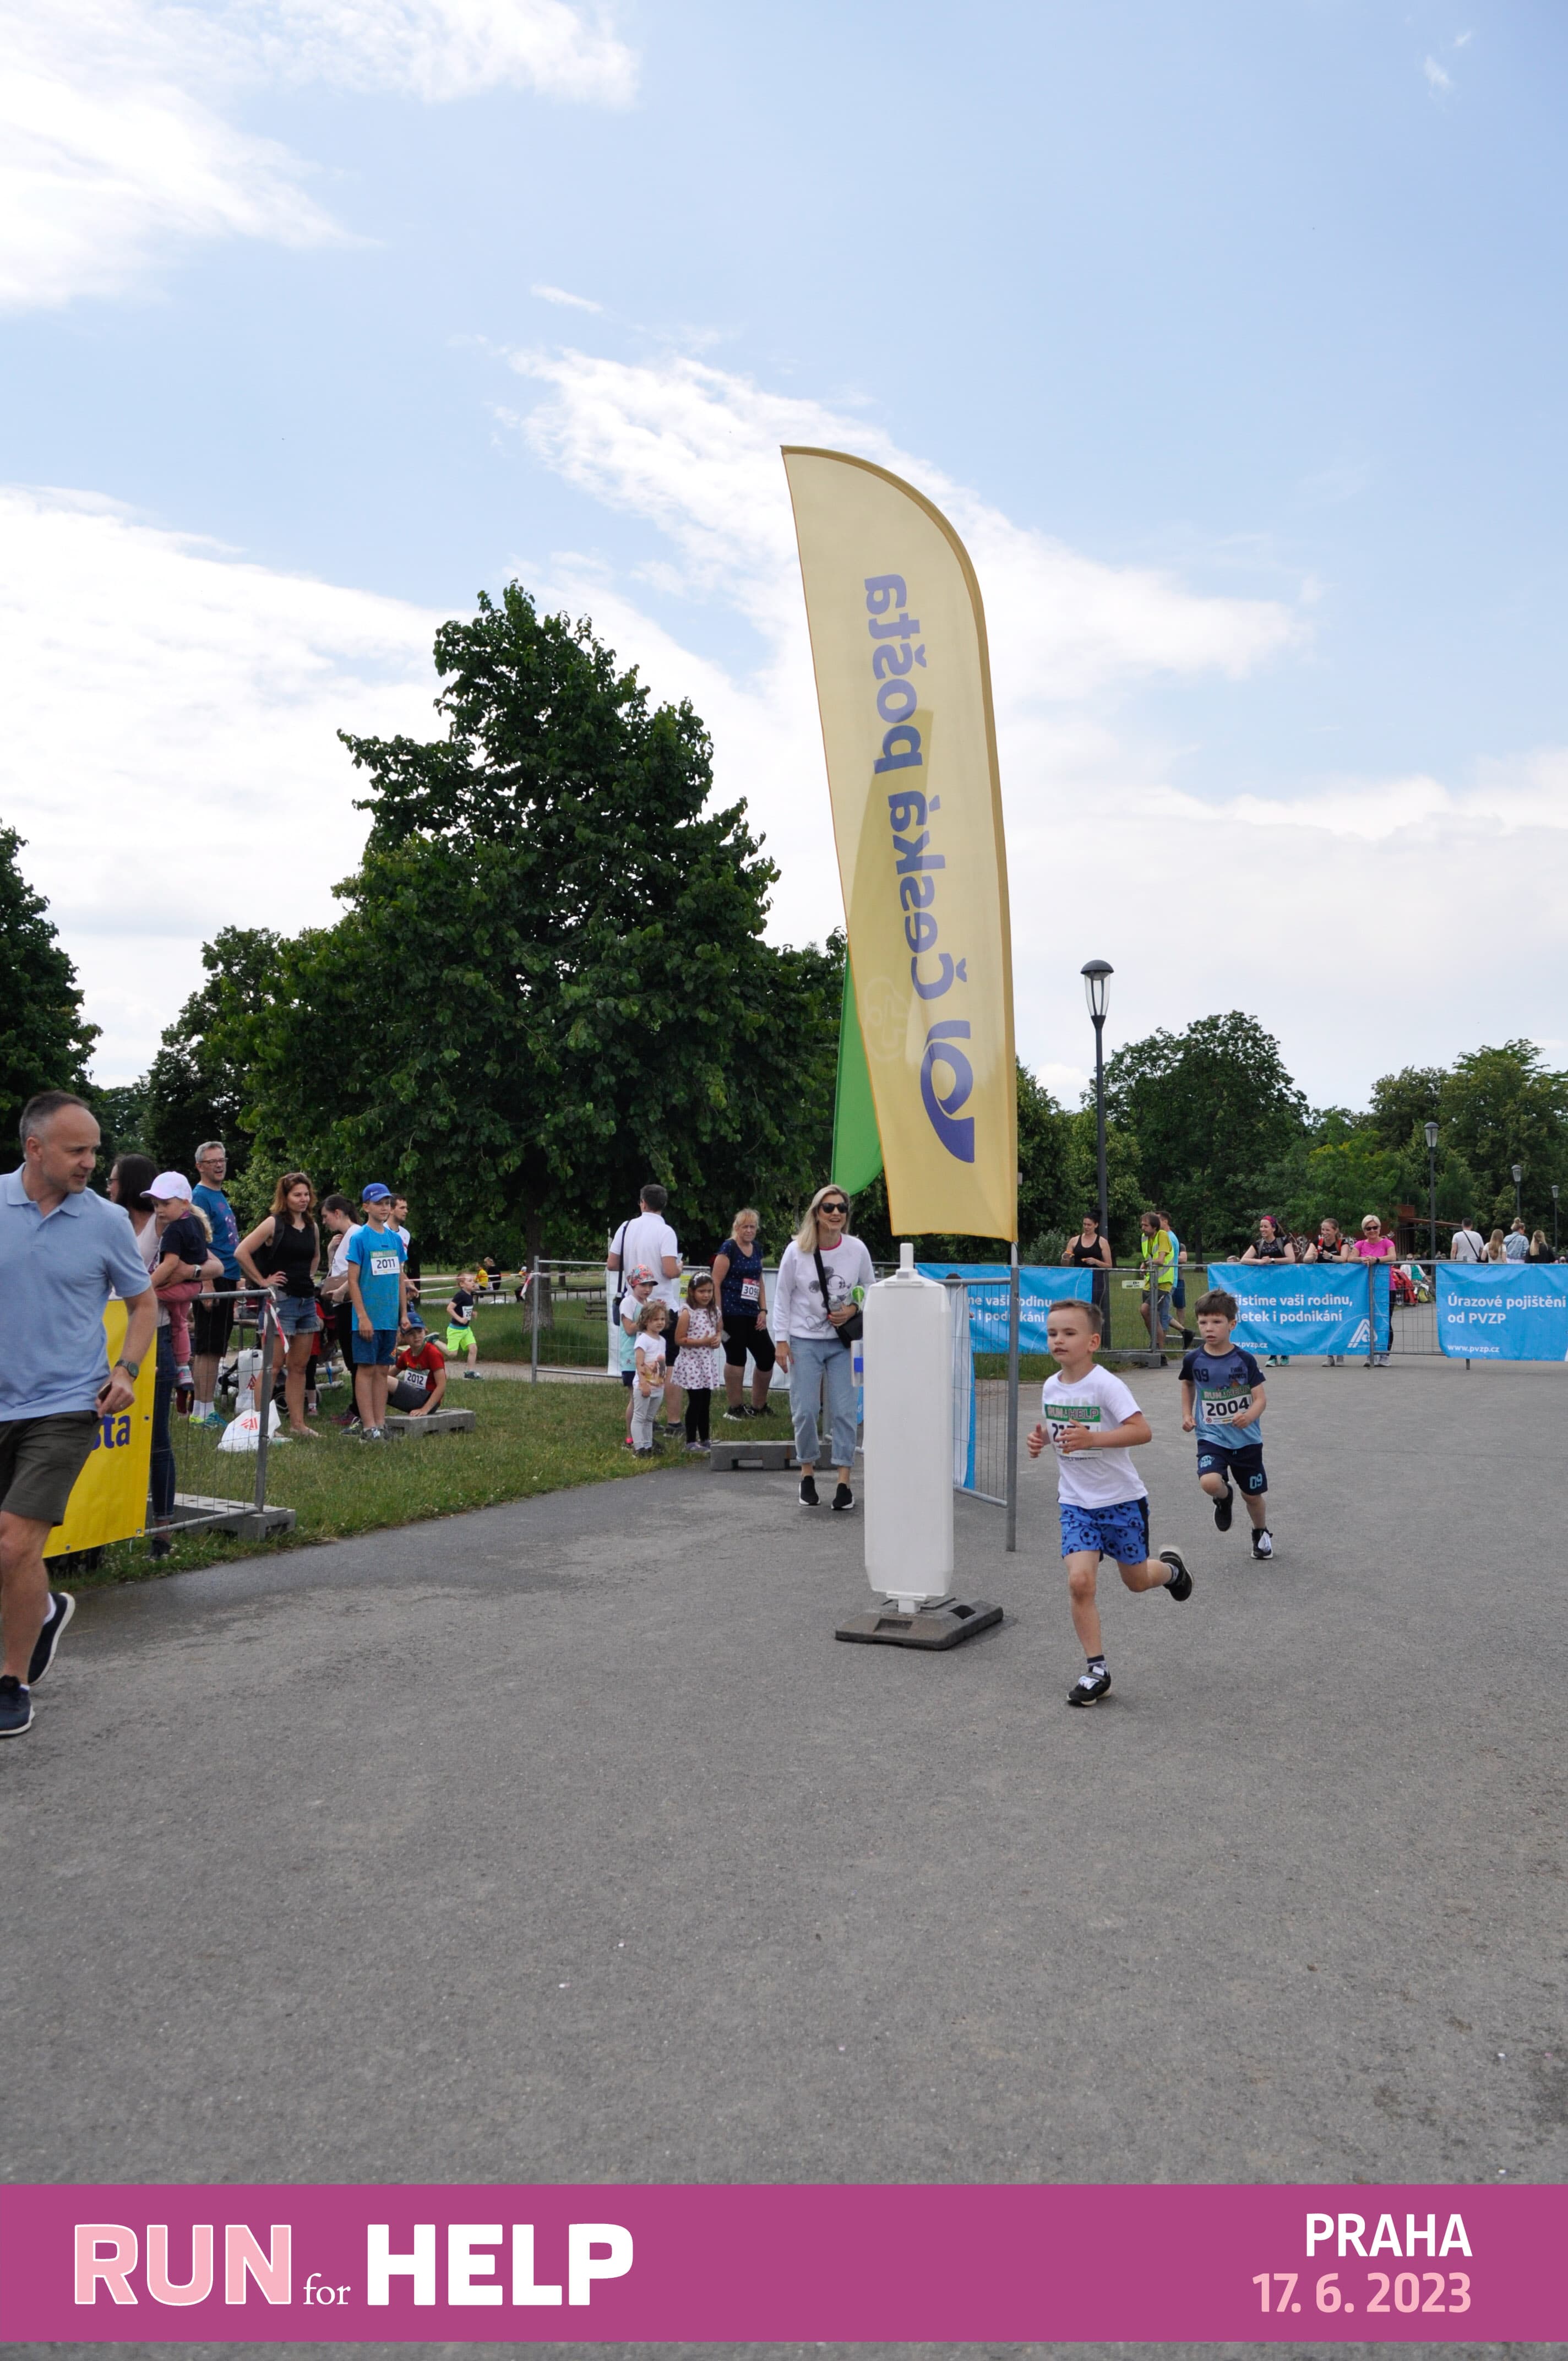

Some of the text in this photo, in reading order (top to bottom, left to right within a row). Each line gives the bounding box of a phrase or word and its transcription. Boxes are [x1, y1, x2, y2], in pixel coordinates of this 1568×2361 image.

[376, 1259, 395, 1269] 2011
[986, 1295, 1010, 1306] vaši
[1017, 1295, 1053, 1307] odinu
[1234, 1294, 1353, 1307] jistíme vaši rodinu,
[1447, 1292, 1566, 1309] Úrazové pojištění
[978, 1310, 982, 1321] i
[985, 1310, 1044, 1323] podkání
[1235, 1310, 1343, 1324] jetek i podnikání
[1447, 1312, 1506, 1324] od PVZP
[1447, 1345, 1500, 1353] www.pvzp.cz
[407, 1372, 424, 1385] 2012
[1206, 1397, 1249, 1416] 2004
[1069, 1408, 1098, 1420] HELP
[1249, 1473, 1262, 1489] 09
